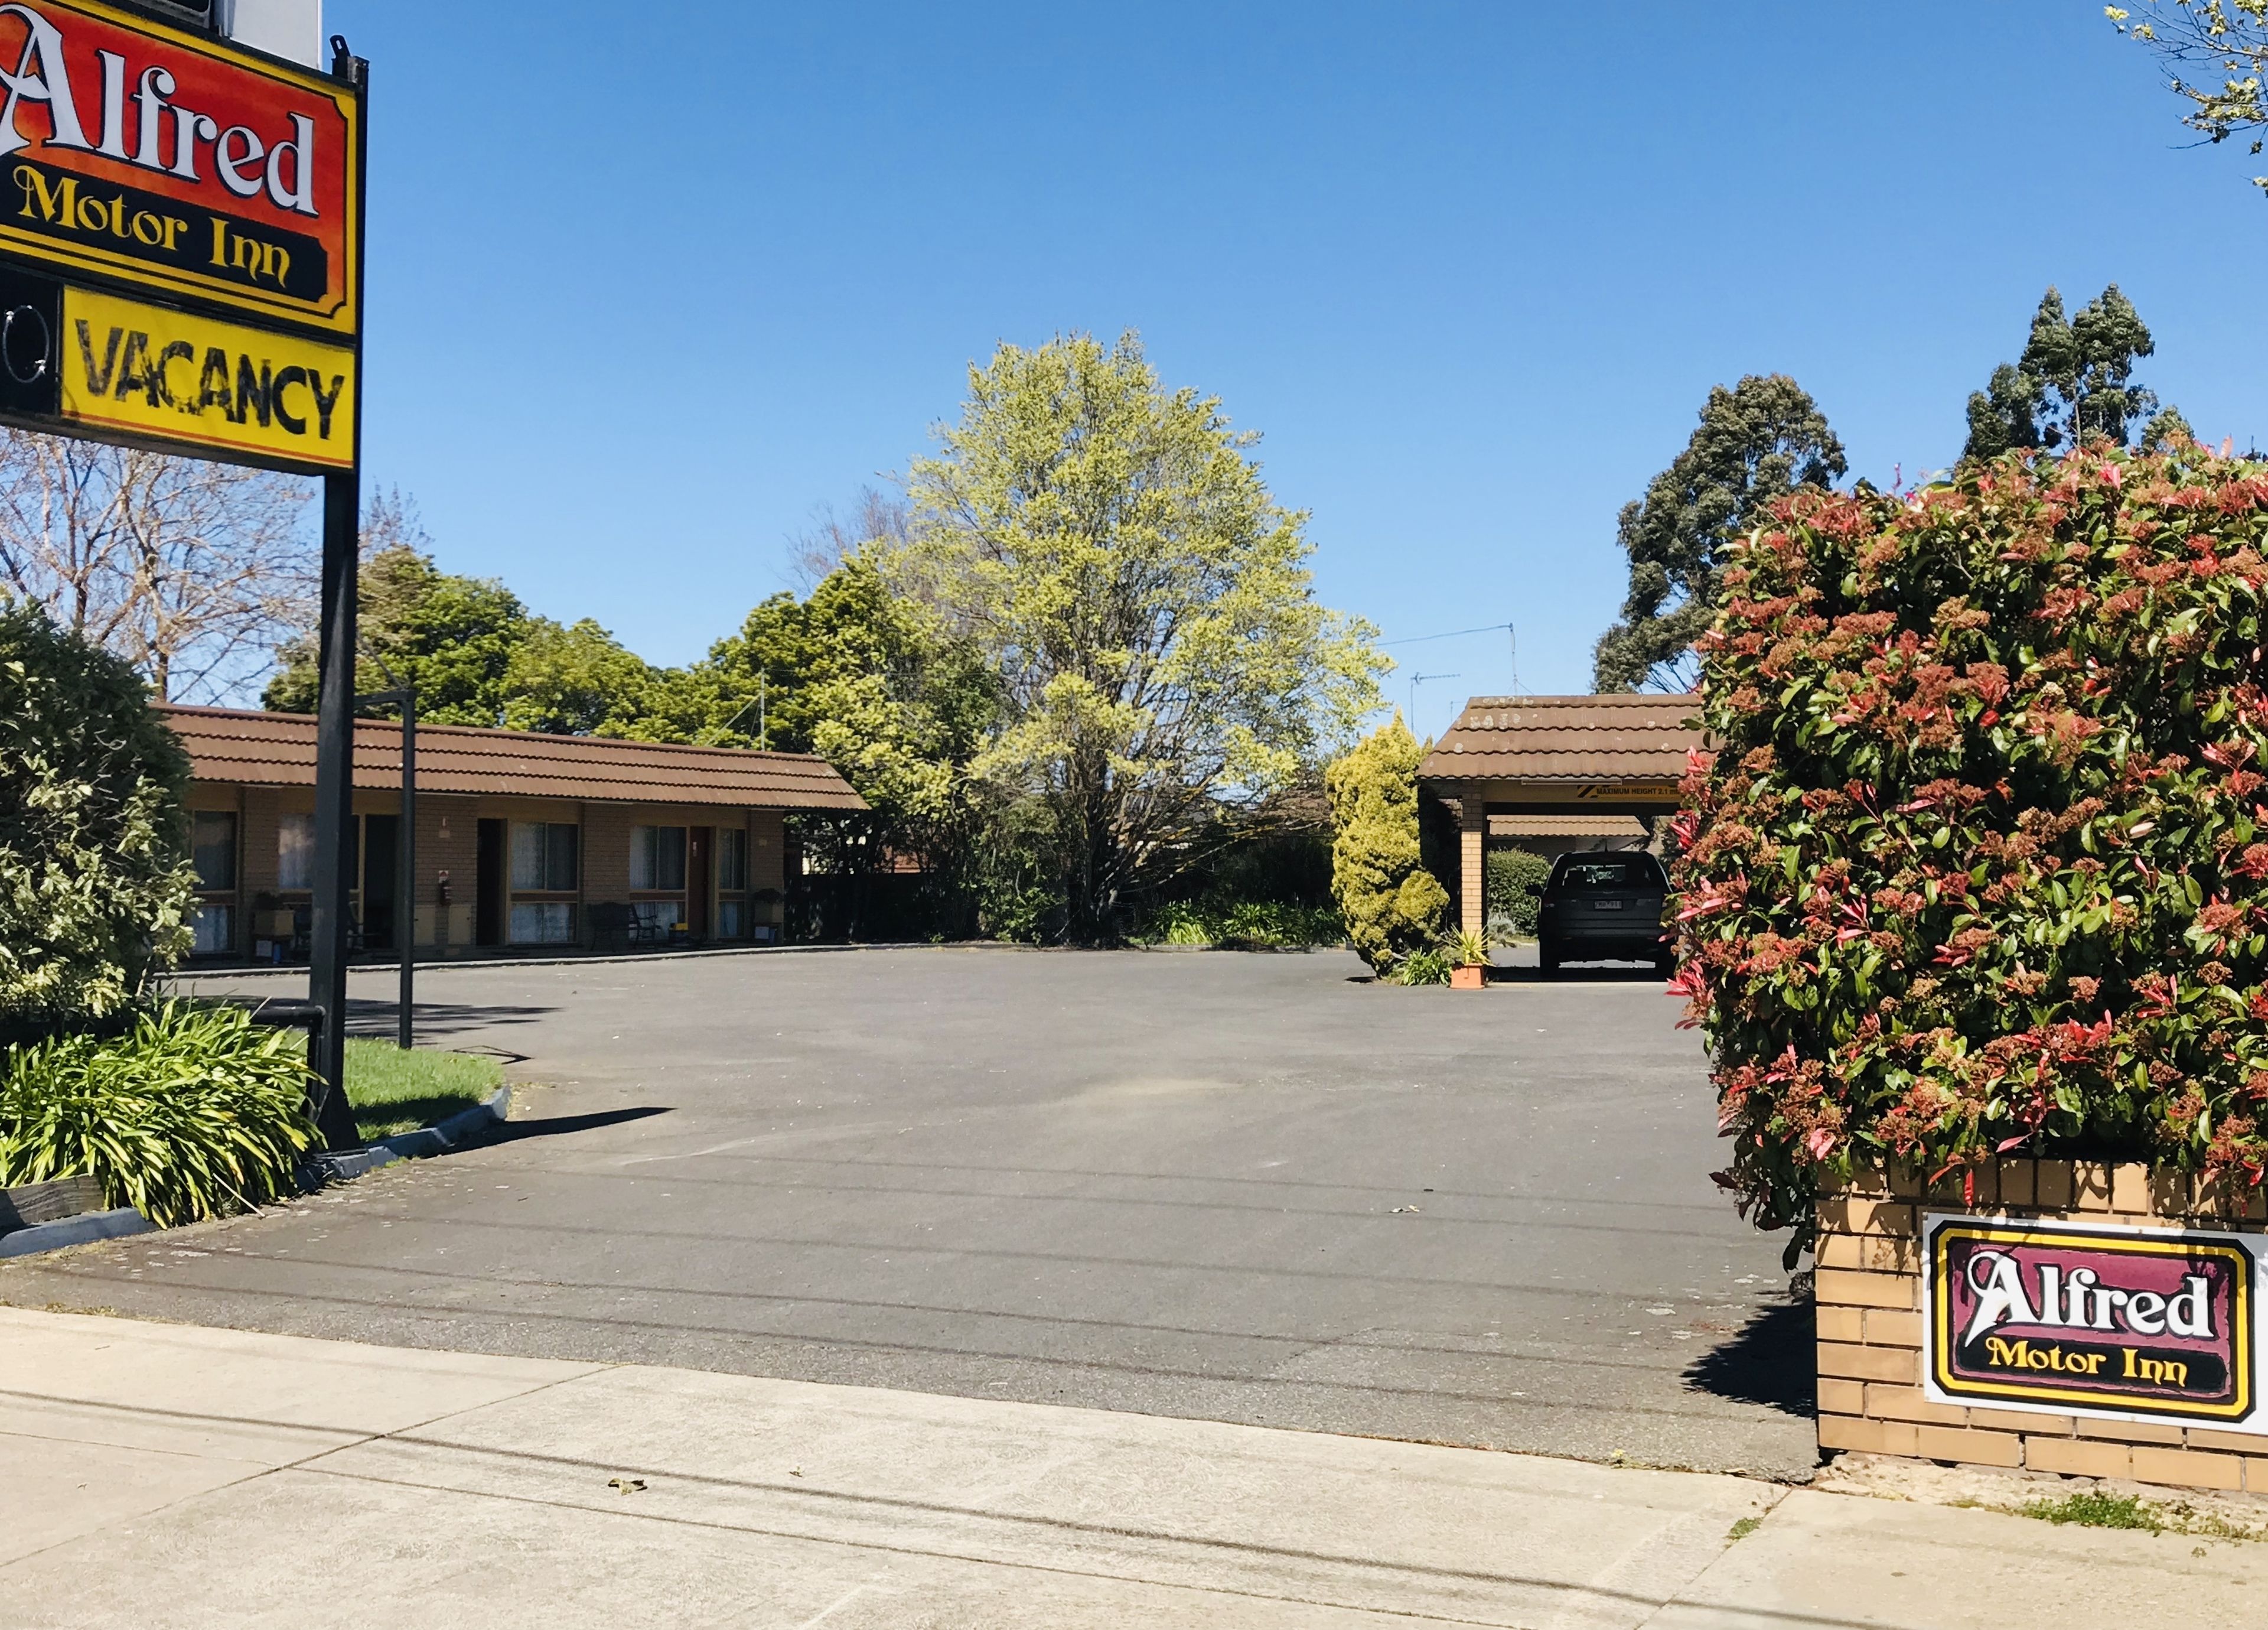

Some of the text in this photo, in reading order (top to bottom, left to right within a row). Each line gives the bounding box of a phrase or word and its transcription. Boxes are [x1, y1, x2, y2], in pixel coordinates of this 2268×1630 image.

[0, 4, 319, 216] Alfred
[14, 165, 291, 288] Motor Inn
[74, 318, 344, 439] VACANCY
[1965, 1251, 2214, 1348] Alfred
[1986, 1337, 2187, 1387] Motor Inn
